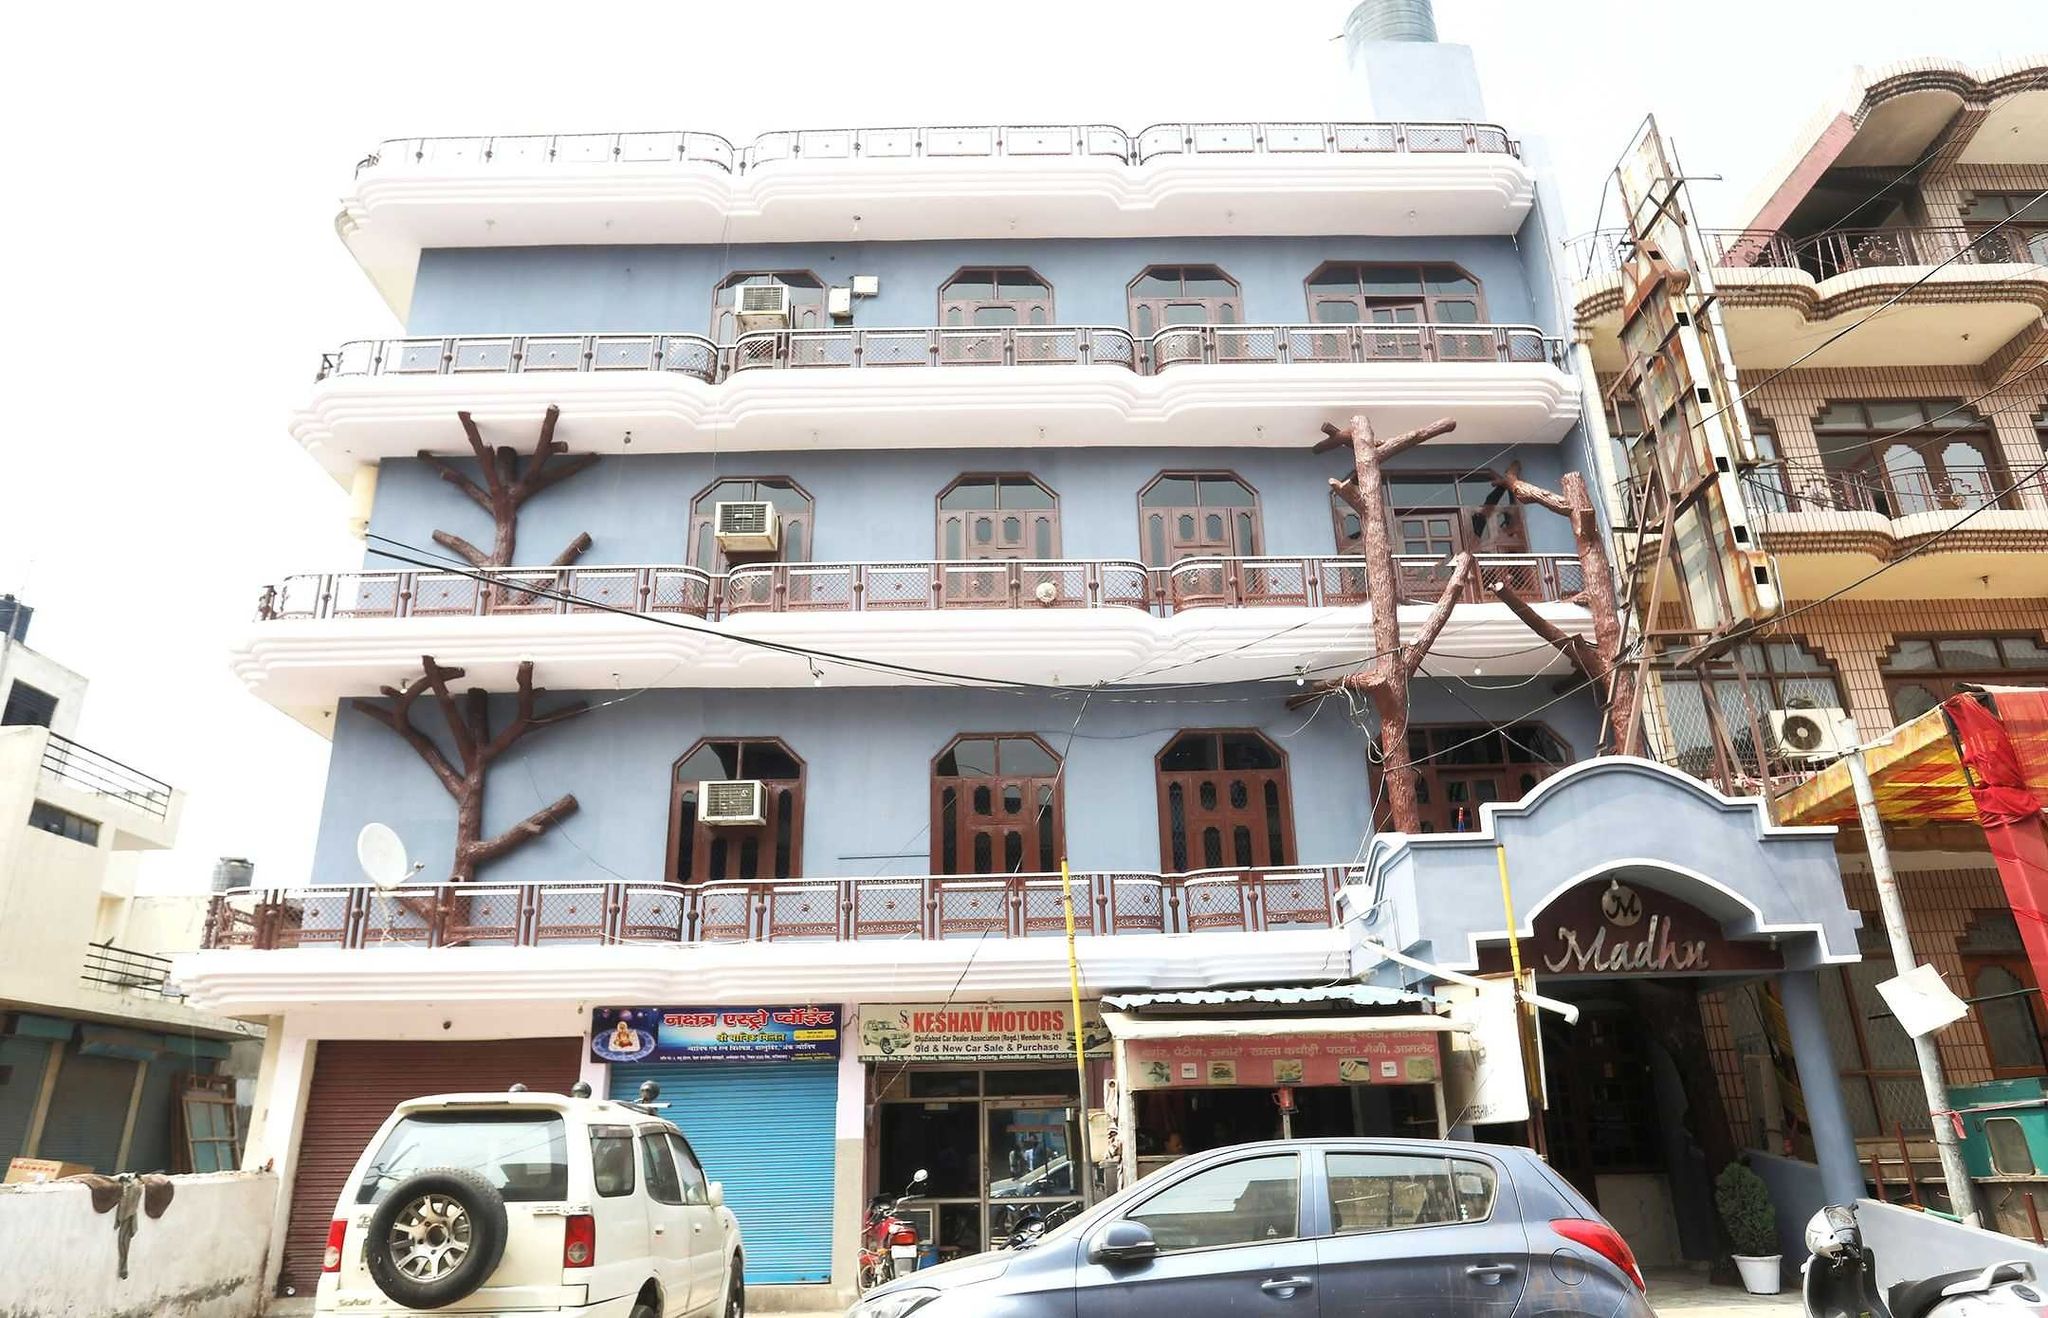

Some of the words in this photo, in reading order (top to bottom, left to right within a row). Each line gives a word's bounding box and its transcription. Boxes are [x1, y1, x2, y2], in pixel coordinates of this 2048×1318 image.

[1543, 914, 1710, 973] Madhu
[663, 1012, 717, 1028] नक्षत्र
[722, 1008, 769, 1031] एस्ट्रो
[912, 1010, 983, 1033] KESHAV
[987, 1010, 1064, 1032] MOTORS
[932, 1044, 939, 1052] &
[942, 1044, 962, 1052] New
[965, 1044, 982, 1052] Car
[984, 1043, 1004, 1052] Sale
[1007, 1043, 1014, 1051] &
[1017, 1043, 1059, 1051] Purchase
[970, 1033, 1000, 1041] Association
